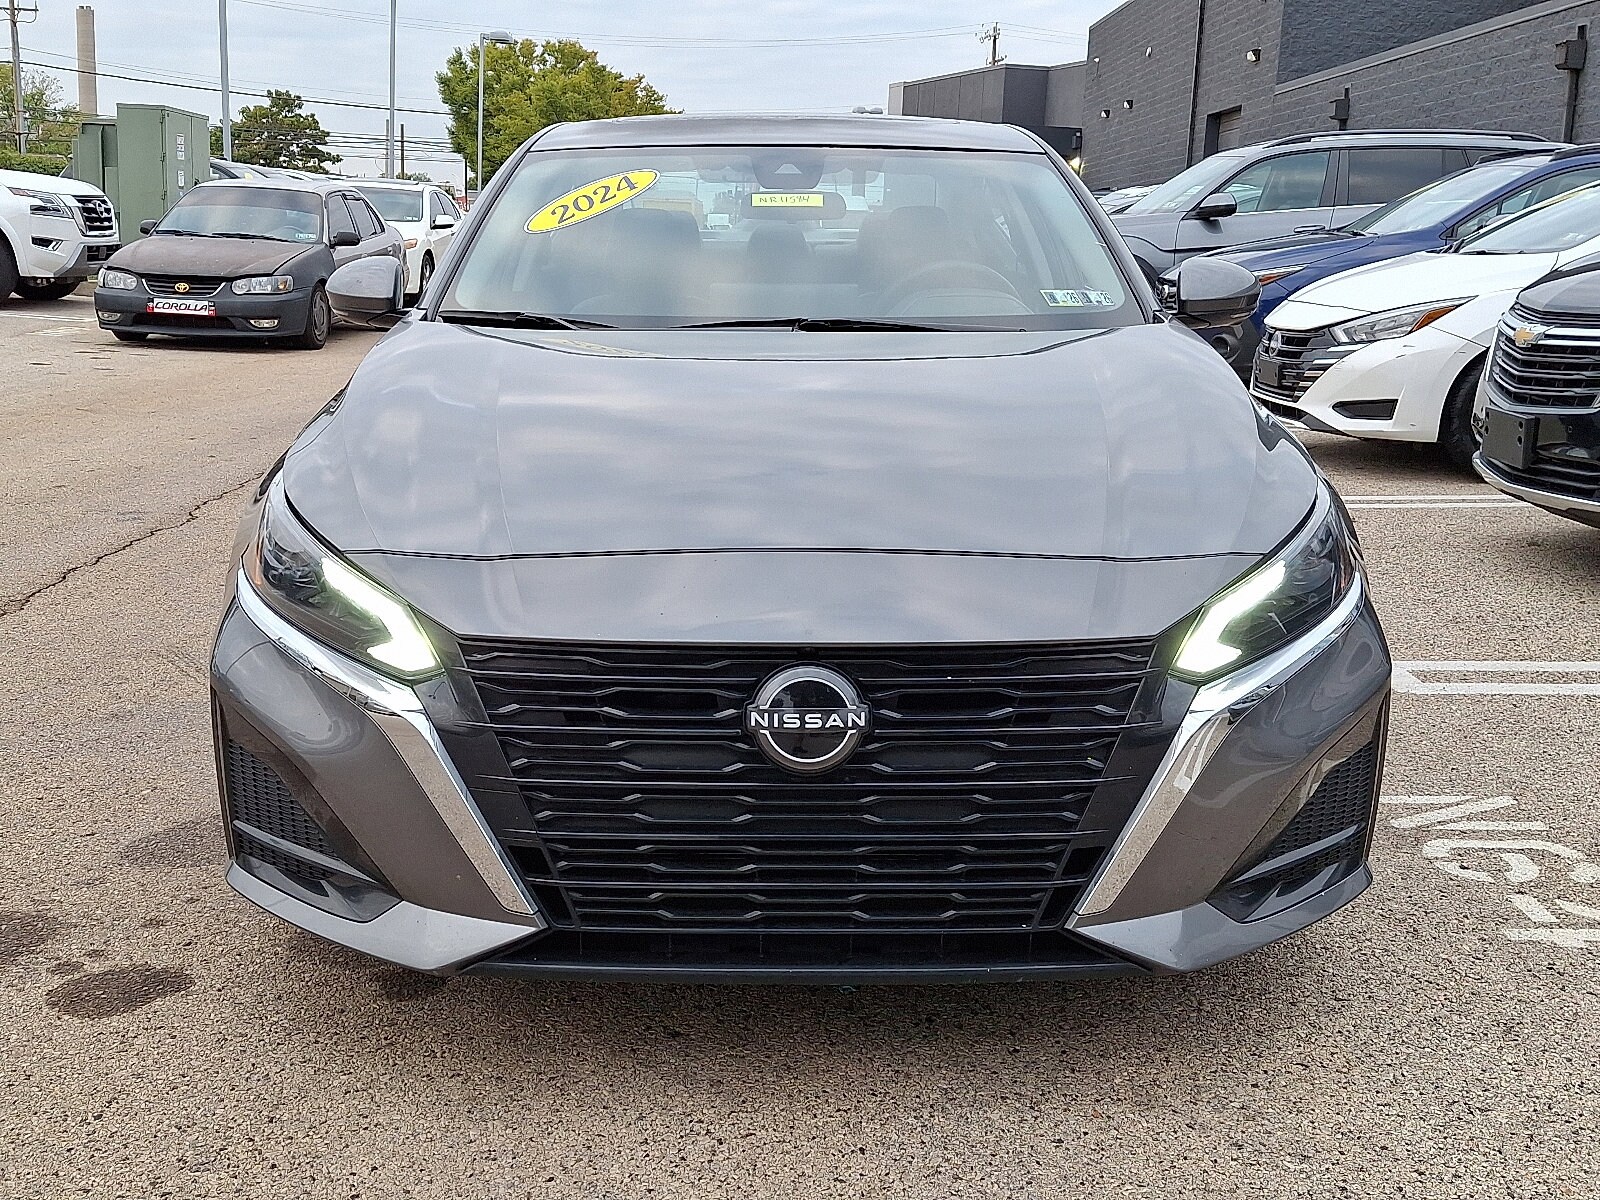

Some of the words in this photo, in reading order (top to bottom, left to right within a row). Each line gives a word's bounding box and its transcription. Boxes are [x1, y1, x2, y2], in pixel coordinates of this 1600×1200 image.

[551, 175, 639, 224] 2024
[154, 301, 208, 312] COROLLA
[750, 711, 866, 729] NISSAN
